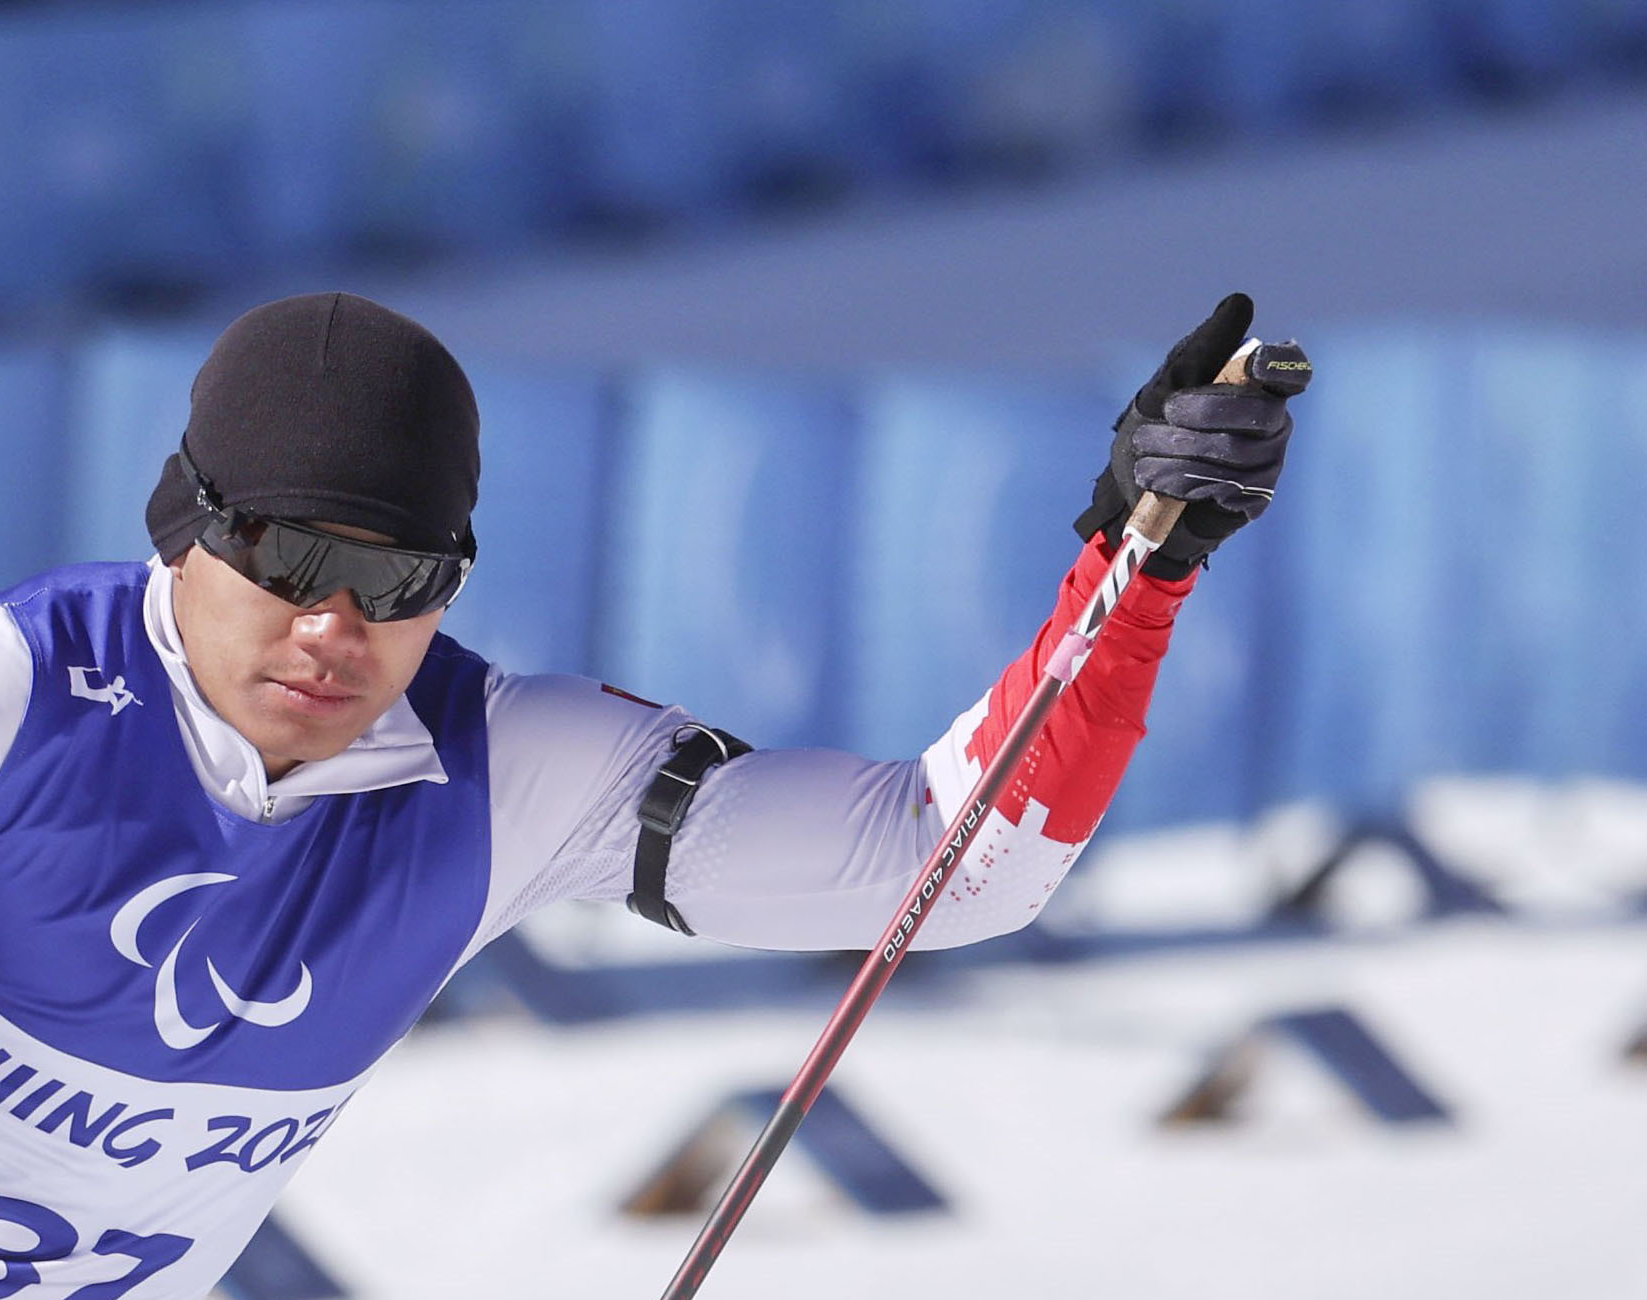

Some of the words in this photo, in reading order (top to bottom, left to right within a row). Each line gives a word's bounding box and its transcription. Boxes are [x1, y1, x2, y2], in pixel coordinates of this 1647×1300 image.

[942, 800, 987, 867] TRIAC
[922, 867, 944, 899] 4.0
[883, 896, 922, 963] AERO
